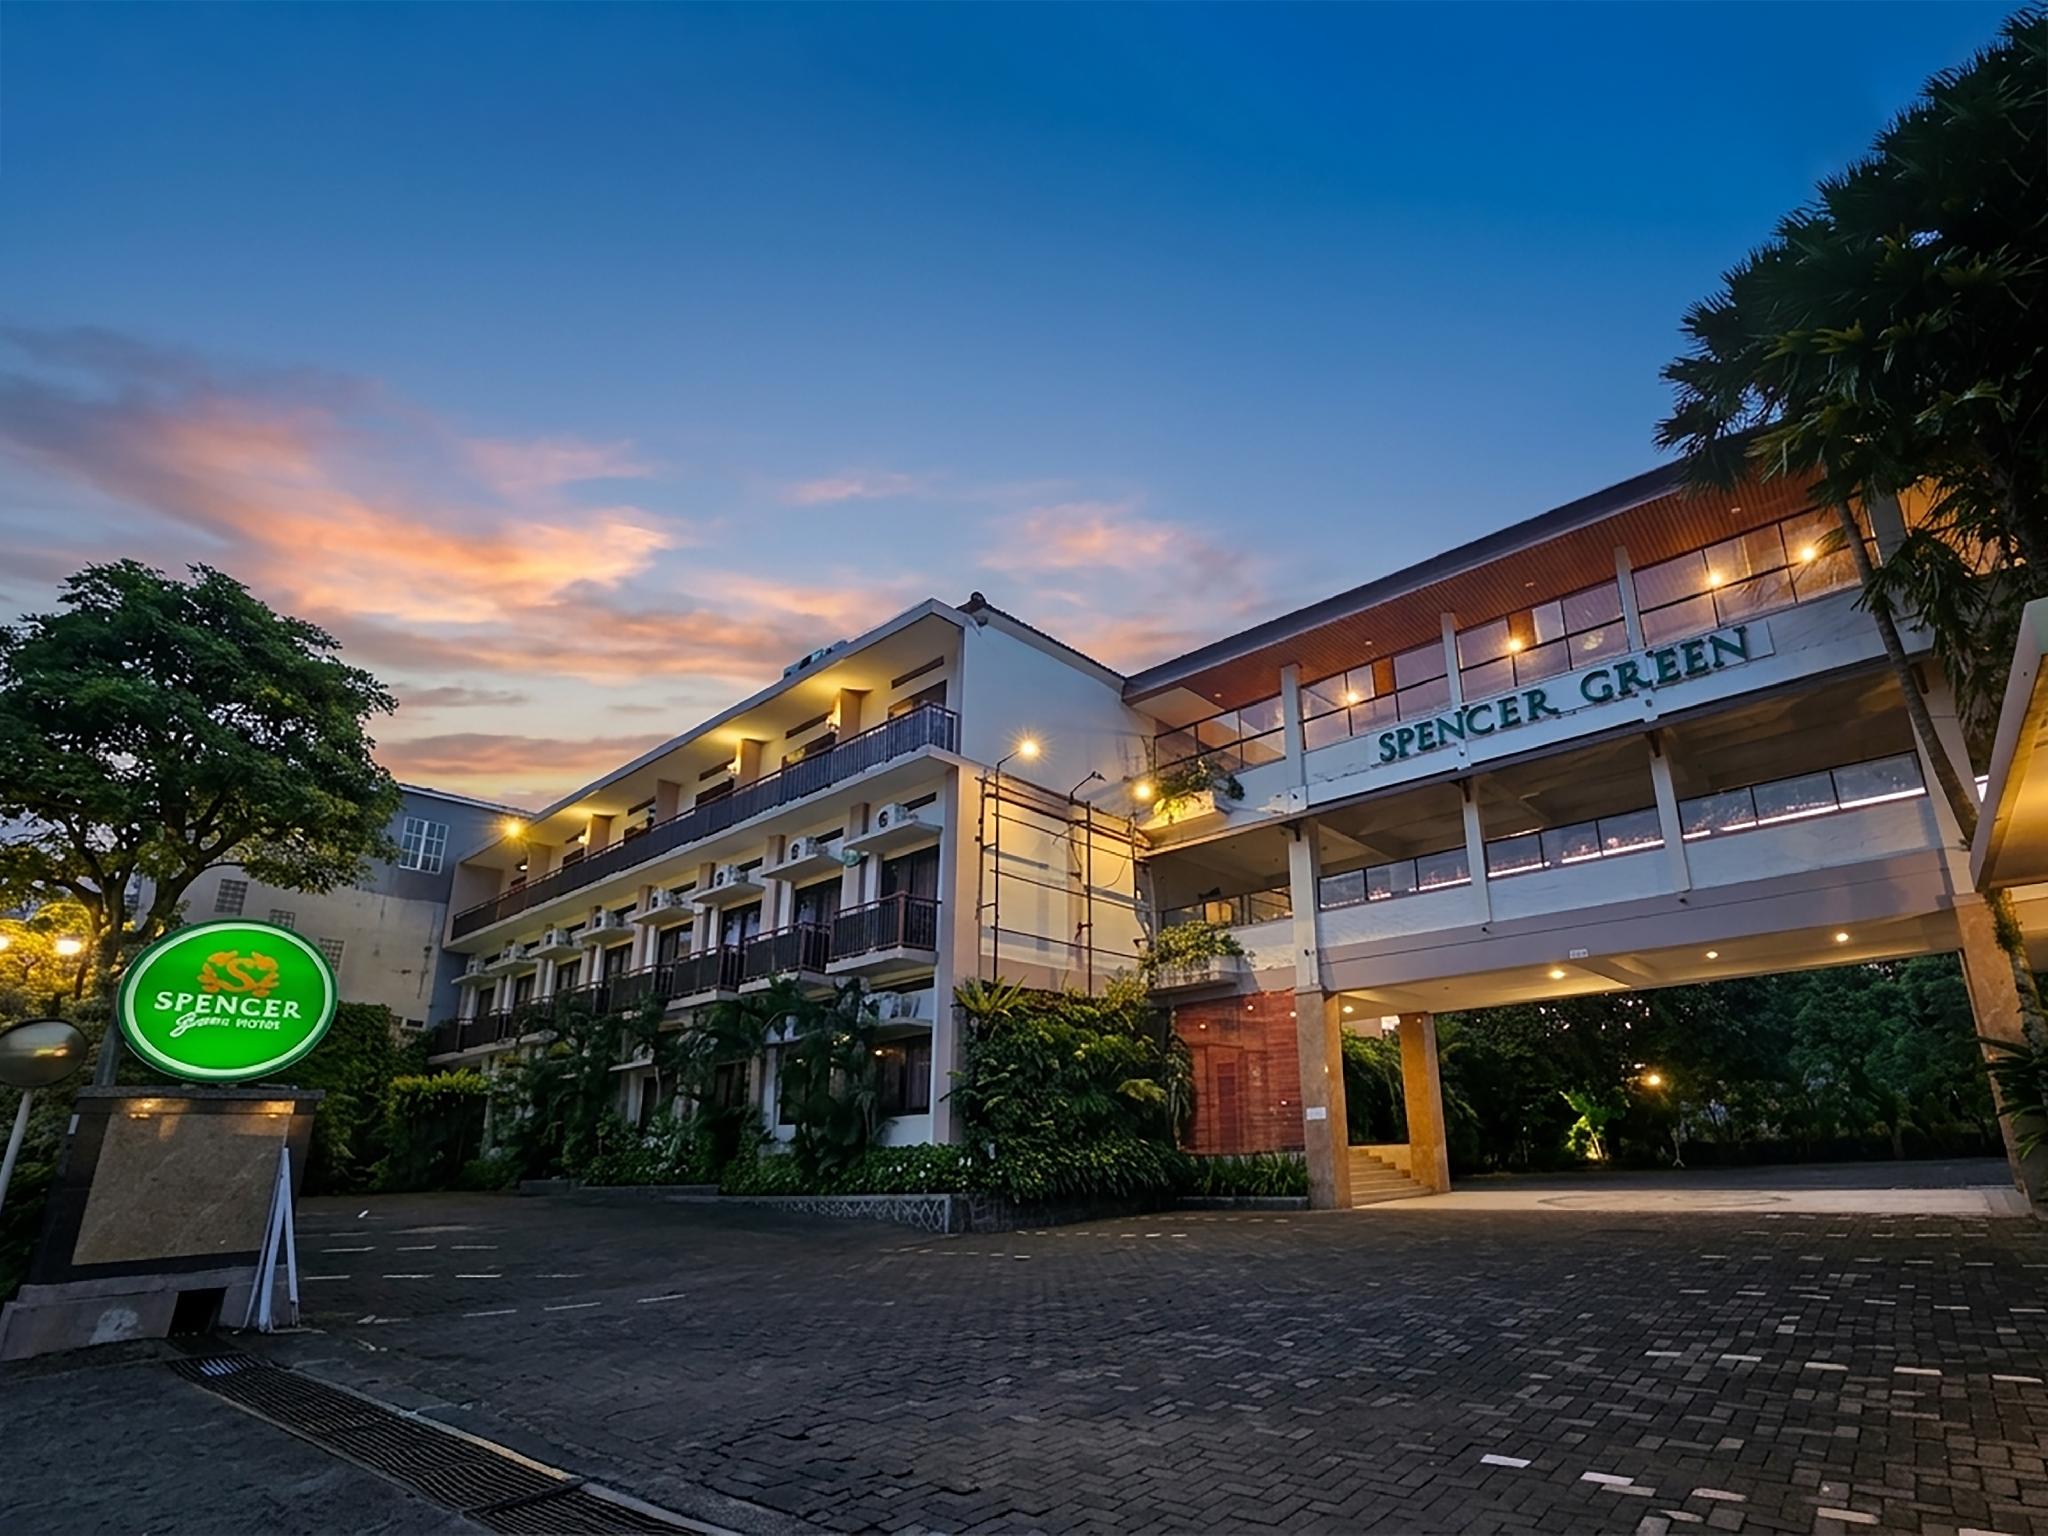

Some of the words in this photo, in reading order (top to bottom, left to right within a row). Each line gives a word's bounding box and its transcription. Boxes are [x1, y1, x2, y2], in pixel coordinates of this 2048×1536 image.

[1379, 689, 1559, 762] SPENCER
[1580, 627, 1748, 702] GREEN
[154, 991, 302, 1019] SPENCER
